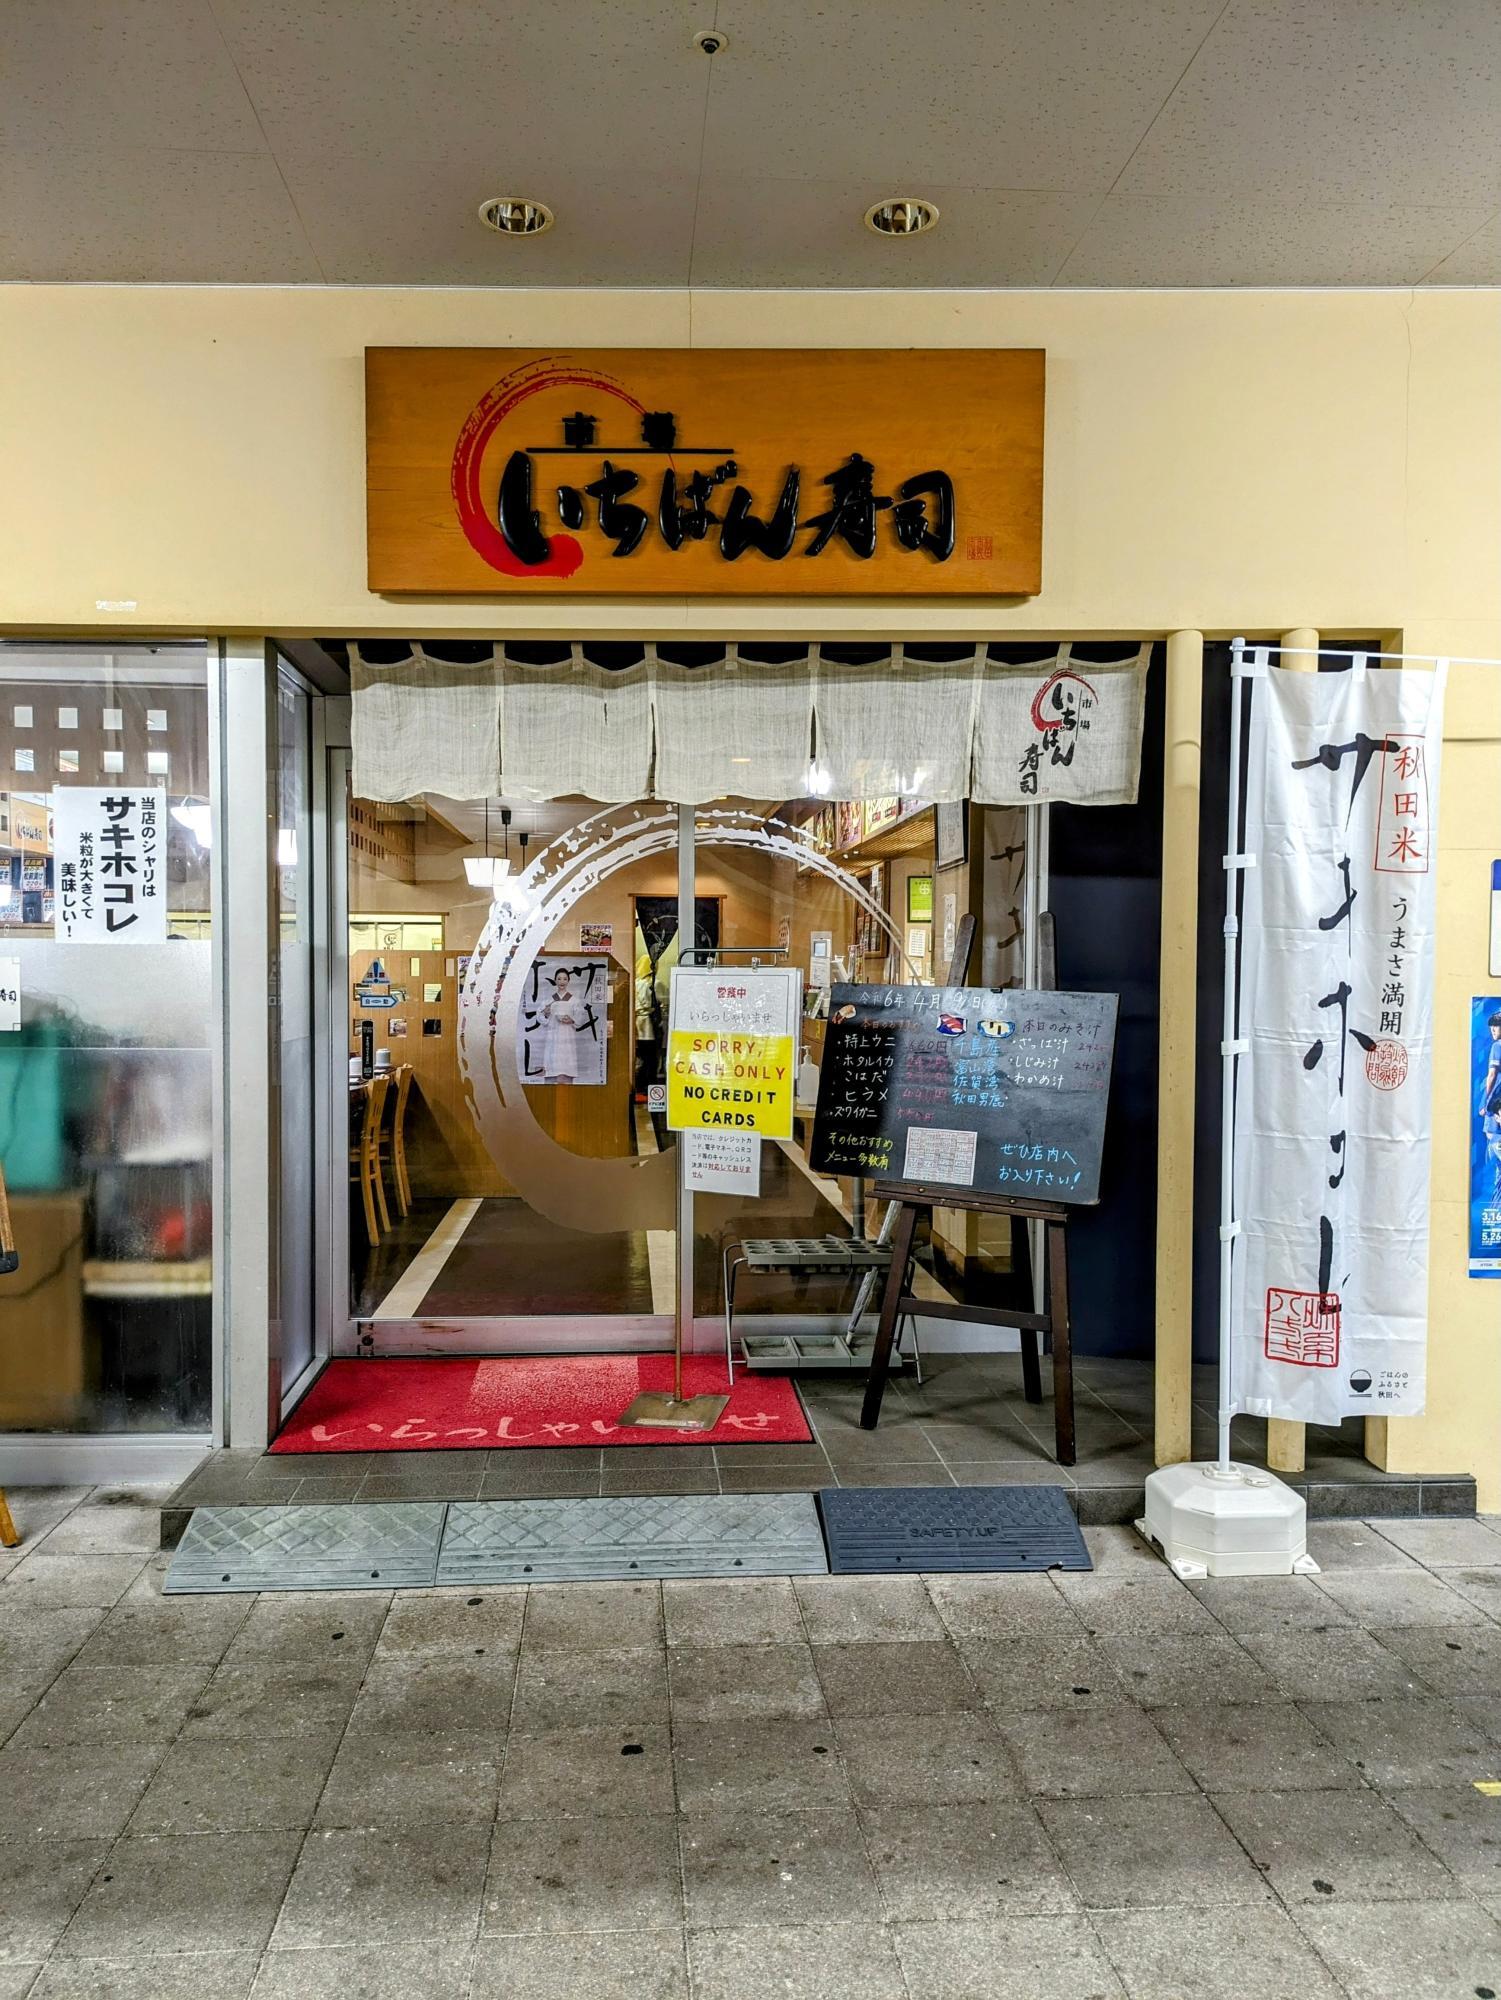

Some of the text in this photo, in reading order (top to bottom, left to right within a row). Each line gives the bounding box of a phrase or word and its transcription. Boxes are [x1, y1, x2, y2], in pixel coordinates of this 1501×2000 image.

[500, 451, 955, 563] いちばん寿司
[1042, 683, 1077, 766] いちばん
[1019, 743, 1044, 795] 寿司
[1387, 745, 1424, 863] 秋田米
[141, 796, 157, 898] 当店のシャリは
[100, 796, 139, 933] サキホコレ
[79, 831, 94, 920] 米粒が大きくて
[1379, 896, 1408, 1036] うまさ満開
[692, 1038, 762, 1058] SORRY,
[675, 1060, 786, 1080] CASH ONLY
[842, 1055, 895, 1067] ホタルイカ
[1015, 1056, 1060, 1070] しじみ汁
[844, 1070, 887, 1083] こはだ
[1014, 1072, 1064, 1090] わかめ汁
[684, 1085, 776, 1105] NO CREDIT
[845, 1087, 889, 1102] ヒラメ
[701, 1110, 756, 1127] CARDS
[1000, 1143, 1078, 1166] ぜひ店内へ
